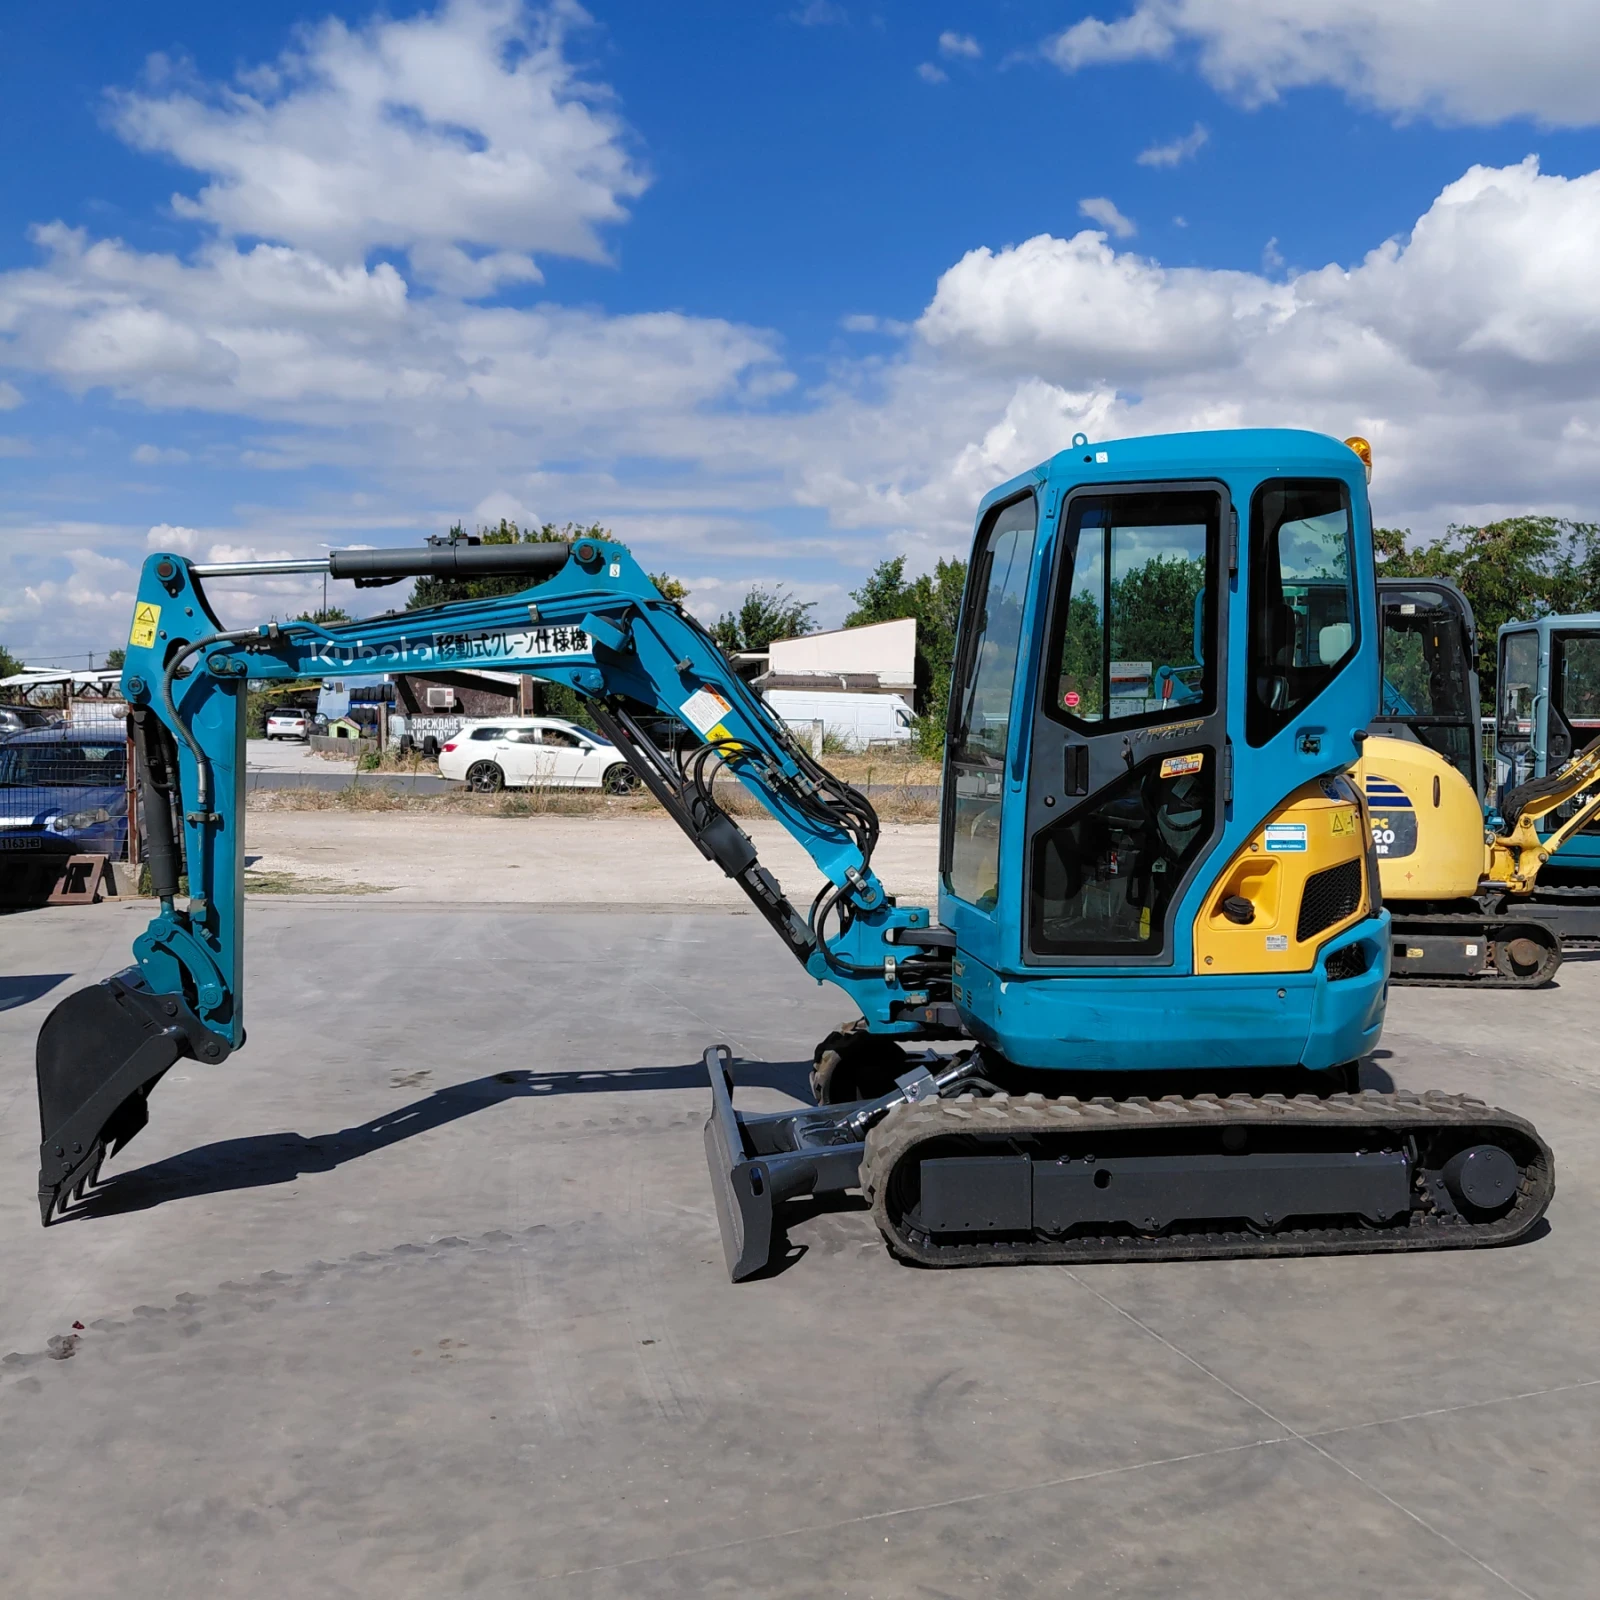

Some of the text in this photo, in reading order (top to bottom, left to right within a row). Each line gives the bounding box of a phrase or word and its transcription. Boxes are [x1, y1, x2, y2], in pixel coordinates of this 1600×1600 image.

[311, 636, 431, 666] Kubota
[435, 628, 588, 661] 移動式クレーン仕様機
[412, 718, 458, 730] ЗАРЕЖДАНЕ
[1370, 818, 1389, 829] PC
[1371, 829, 1396, 844] 20
